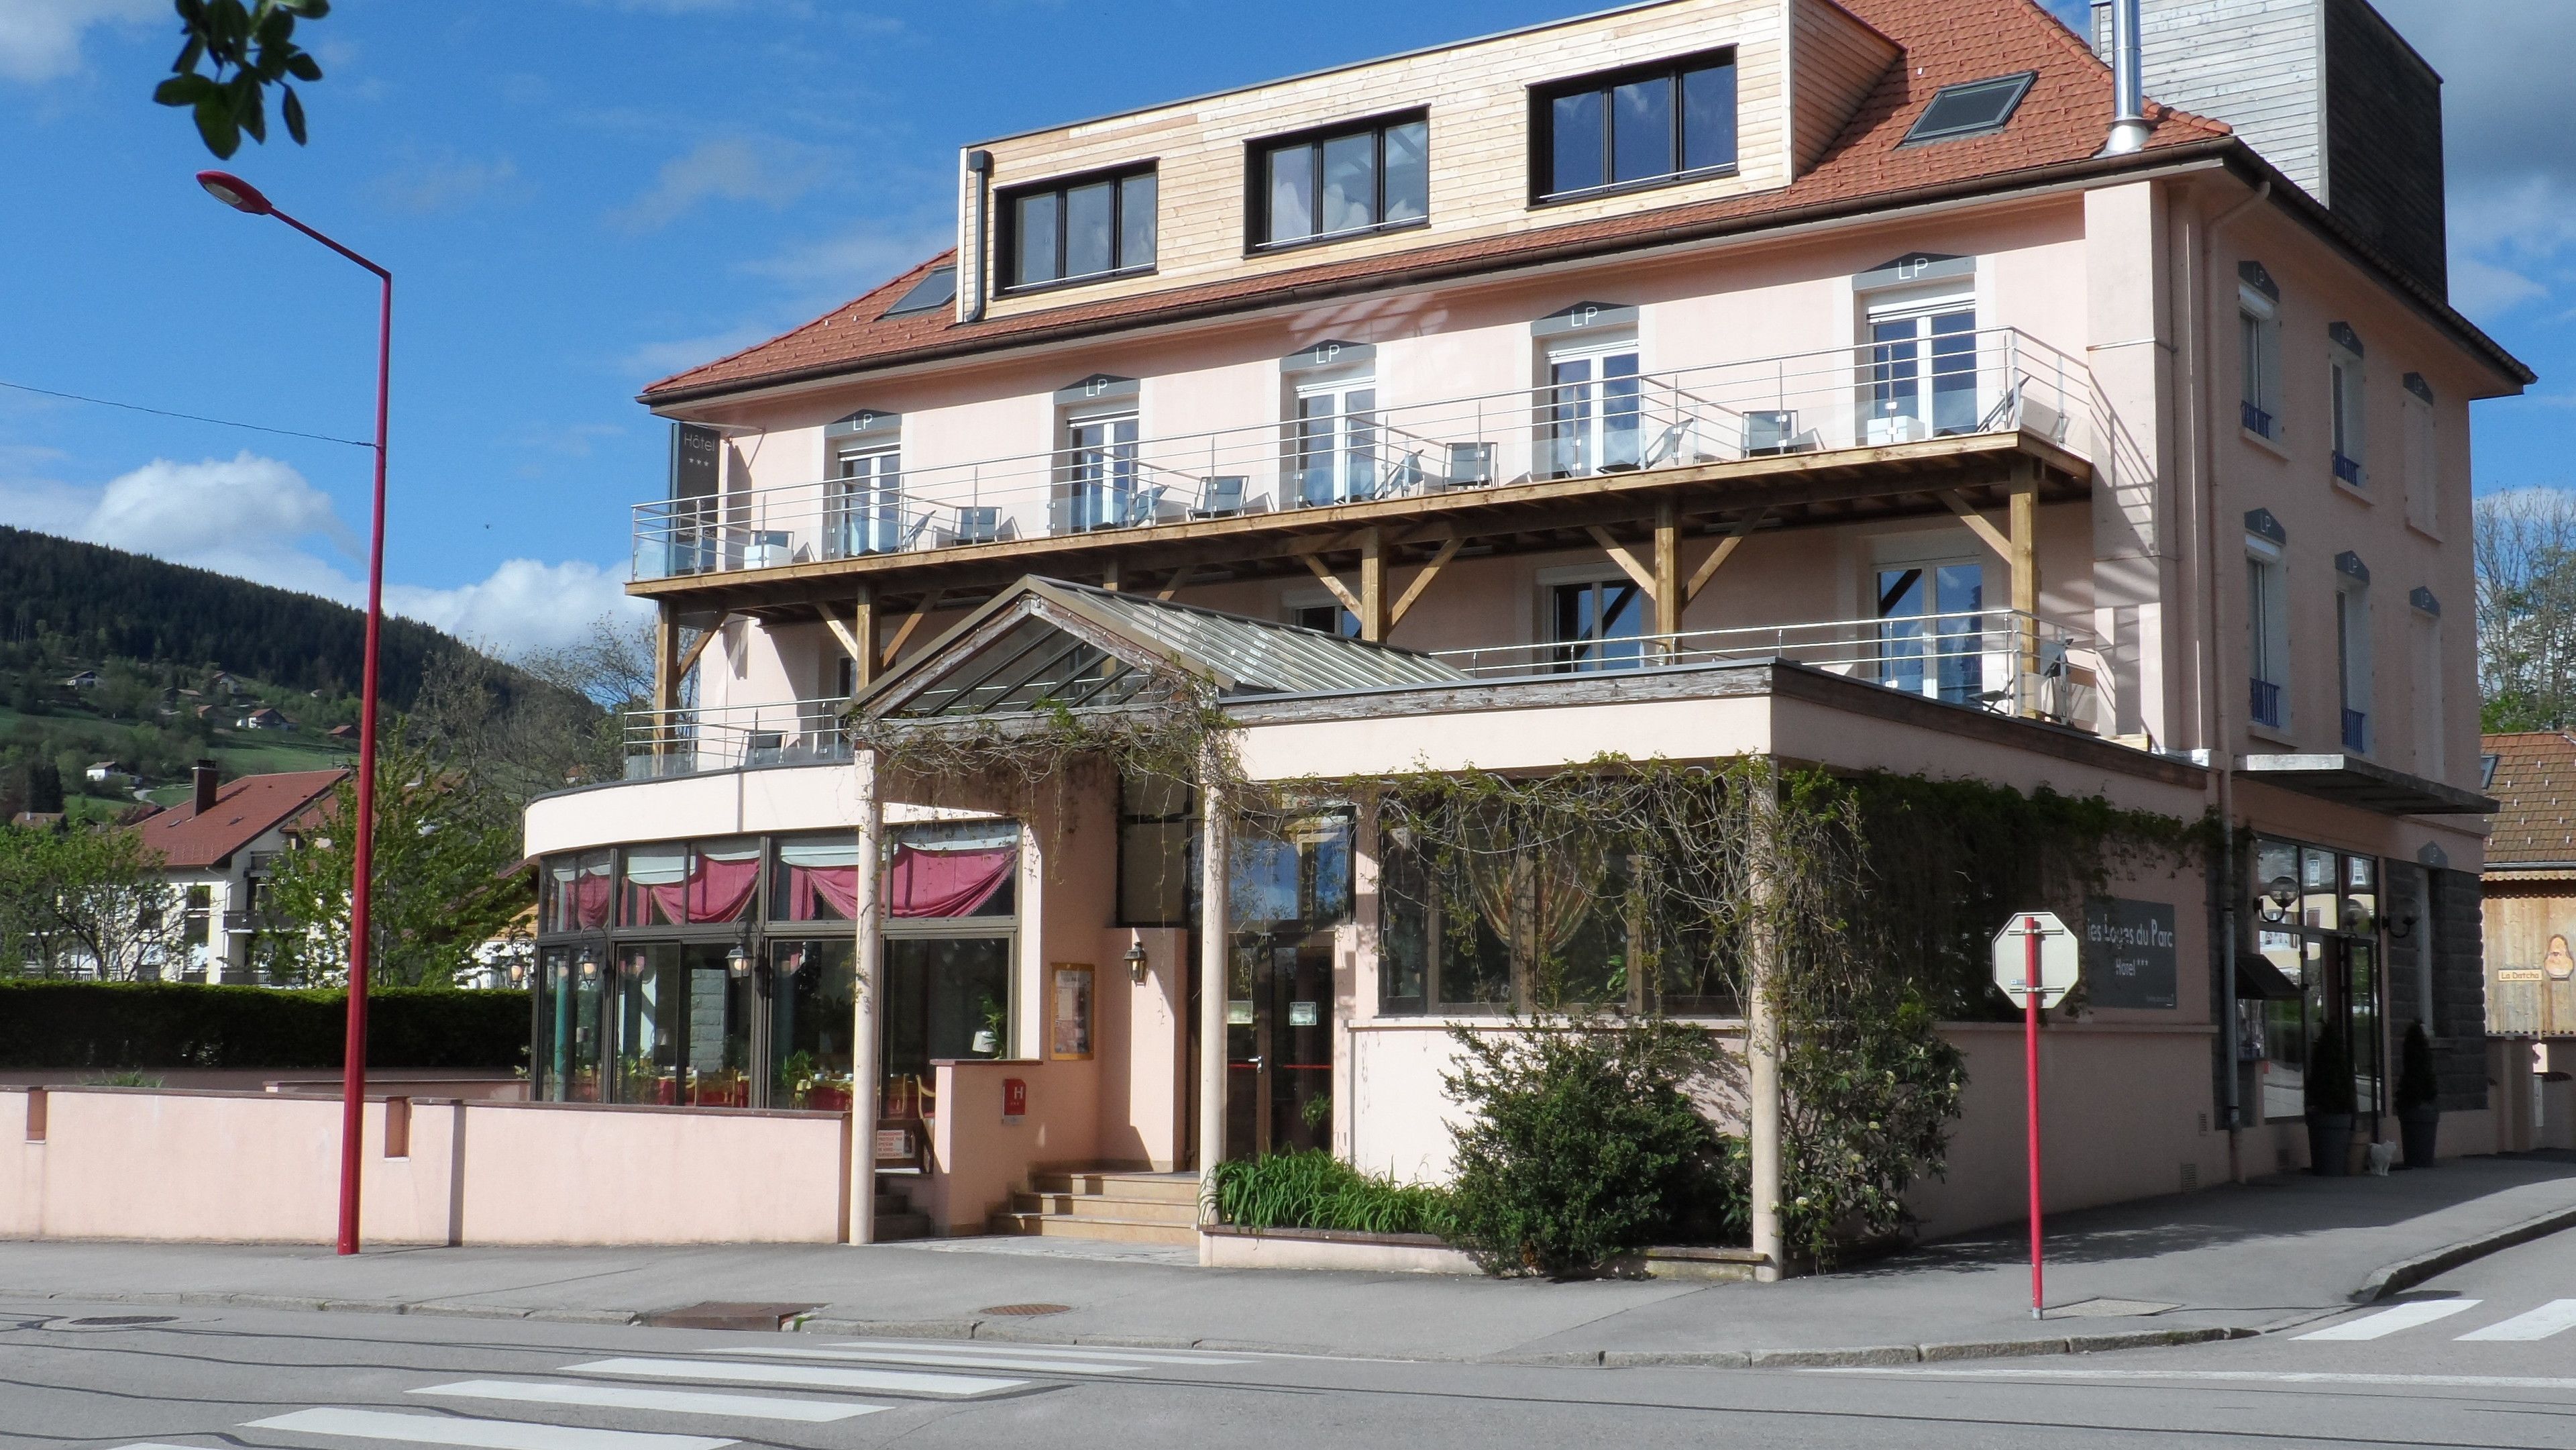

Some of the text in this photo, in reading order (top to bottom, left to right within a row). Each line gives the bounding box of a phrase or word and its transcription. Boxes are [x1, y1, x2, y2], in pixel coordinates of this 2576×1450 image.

[1898, 258, 1929, 280] LP
[1571, 306, 1598, 327] LP
[1316, 344, 1340, 364] LP
[1086, 378, 1108, 397] LP
[853, 413, 873, 431] LP
[684, 432, 716, 452] Hôtel
[2136, 923, 2149, 946] du
[2151, 919, 2174, 948] Parc
[2512, 971, 2539, 979] Datcha
[1014, 1086, 1024, 1100] H
